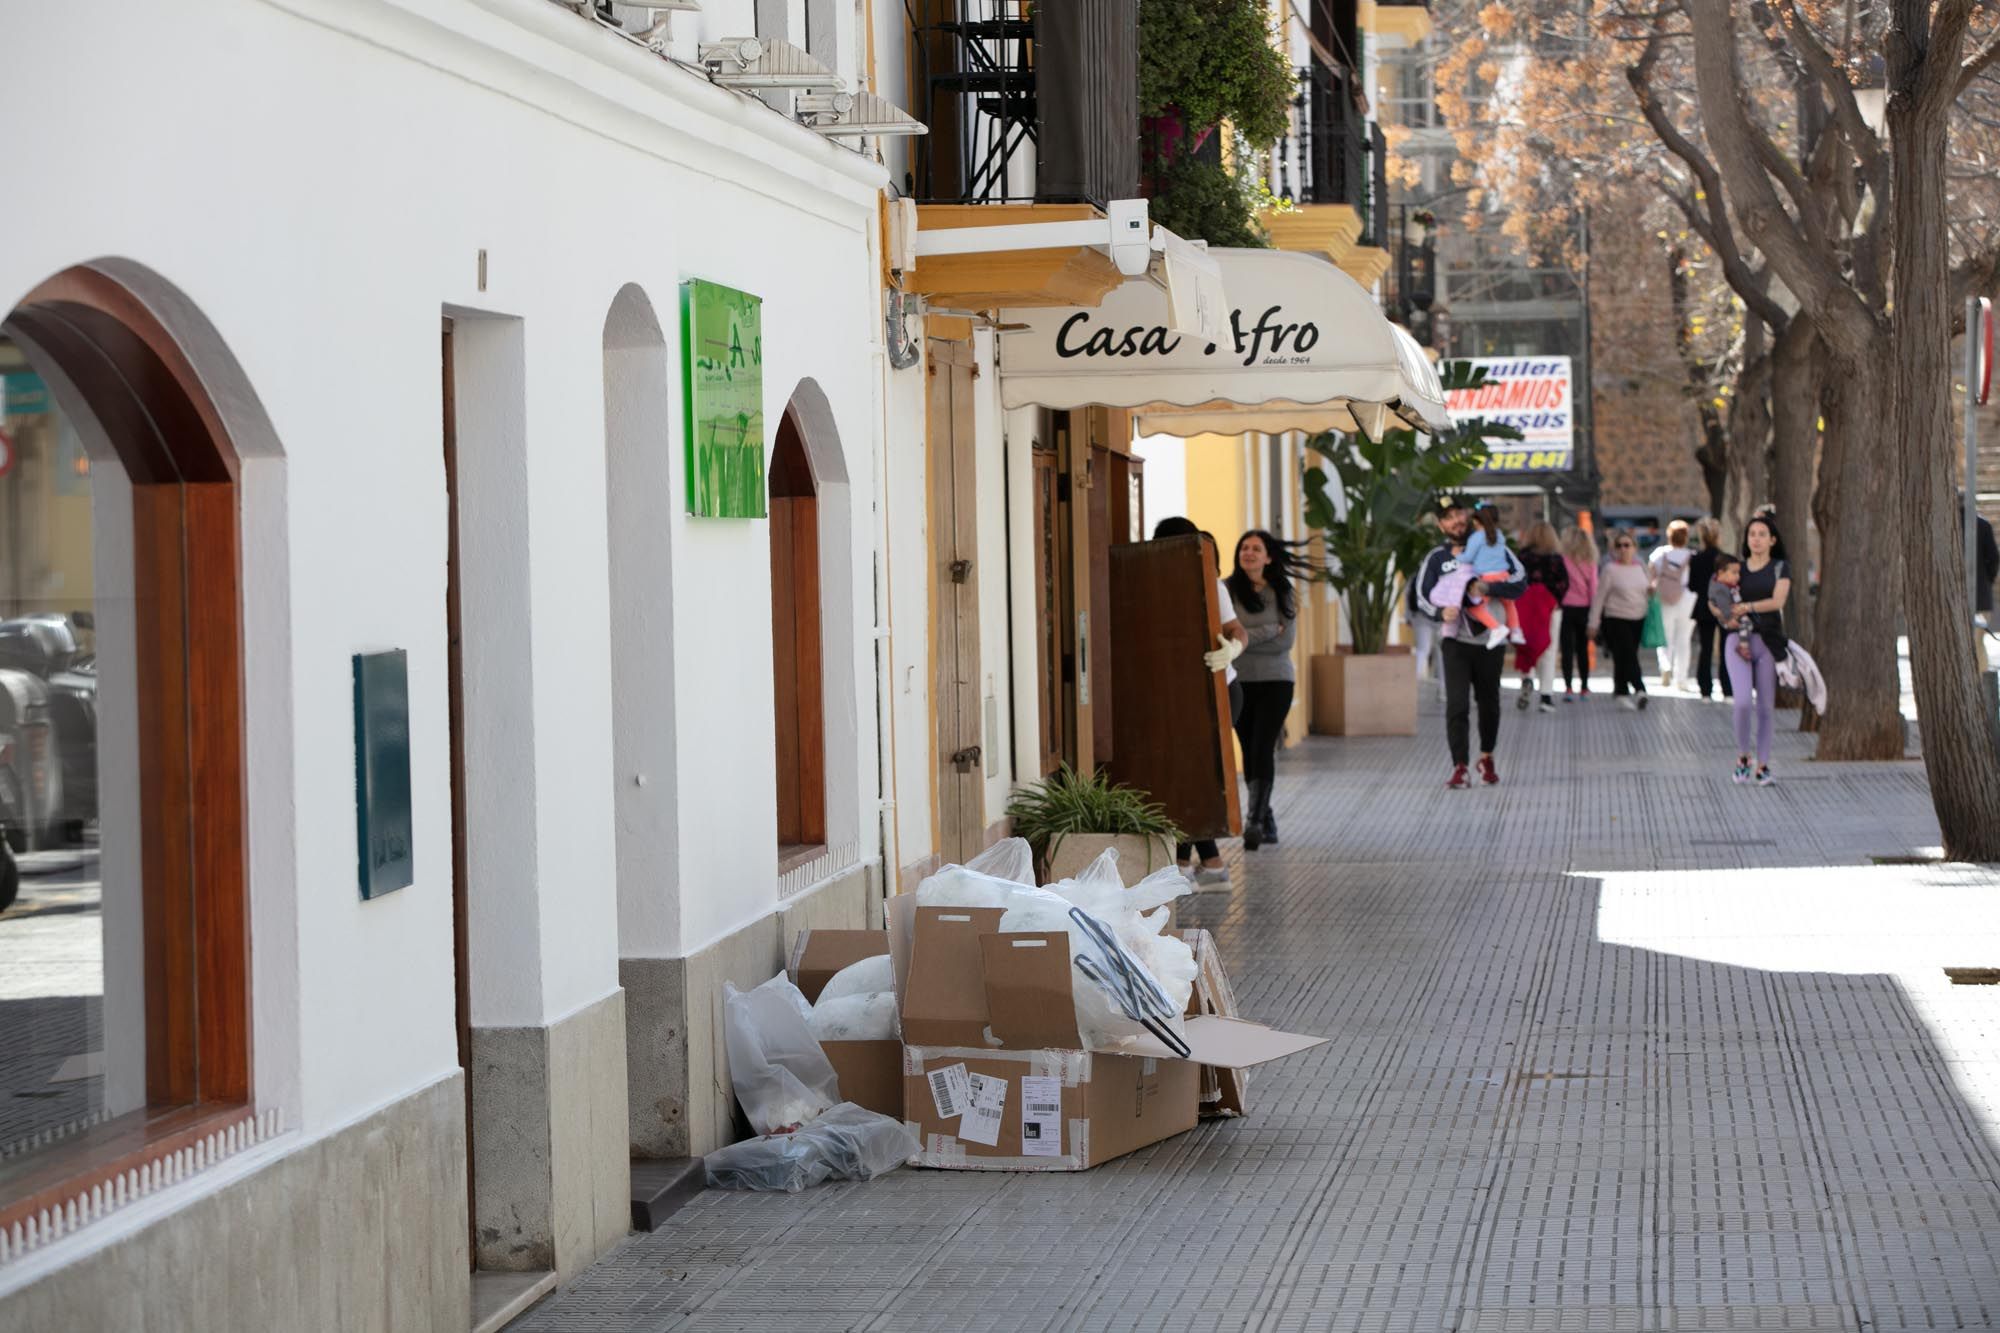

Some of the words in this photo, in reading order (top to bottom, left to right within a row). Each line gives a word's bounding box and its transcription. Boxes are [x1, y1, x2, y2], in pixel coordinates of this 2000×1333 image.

[1056, 311, 1181, 358] Casa
[1263, 355, 1287, 365] desde
[1290, 355, 1311, 365] 1964
